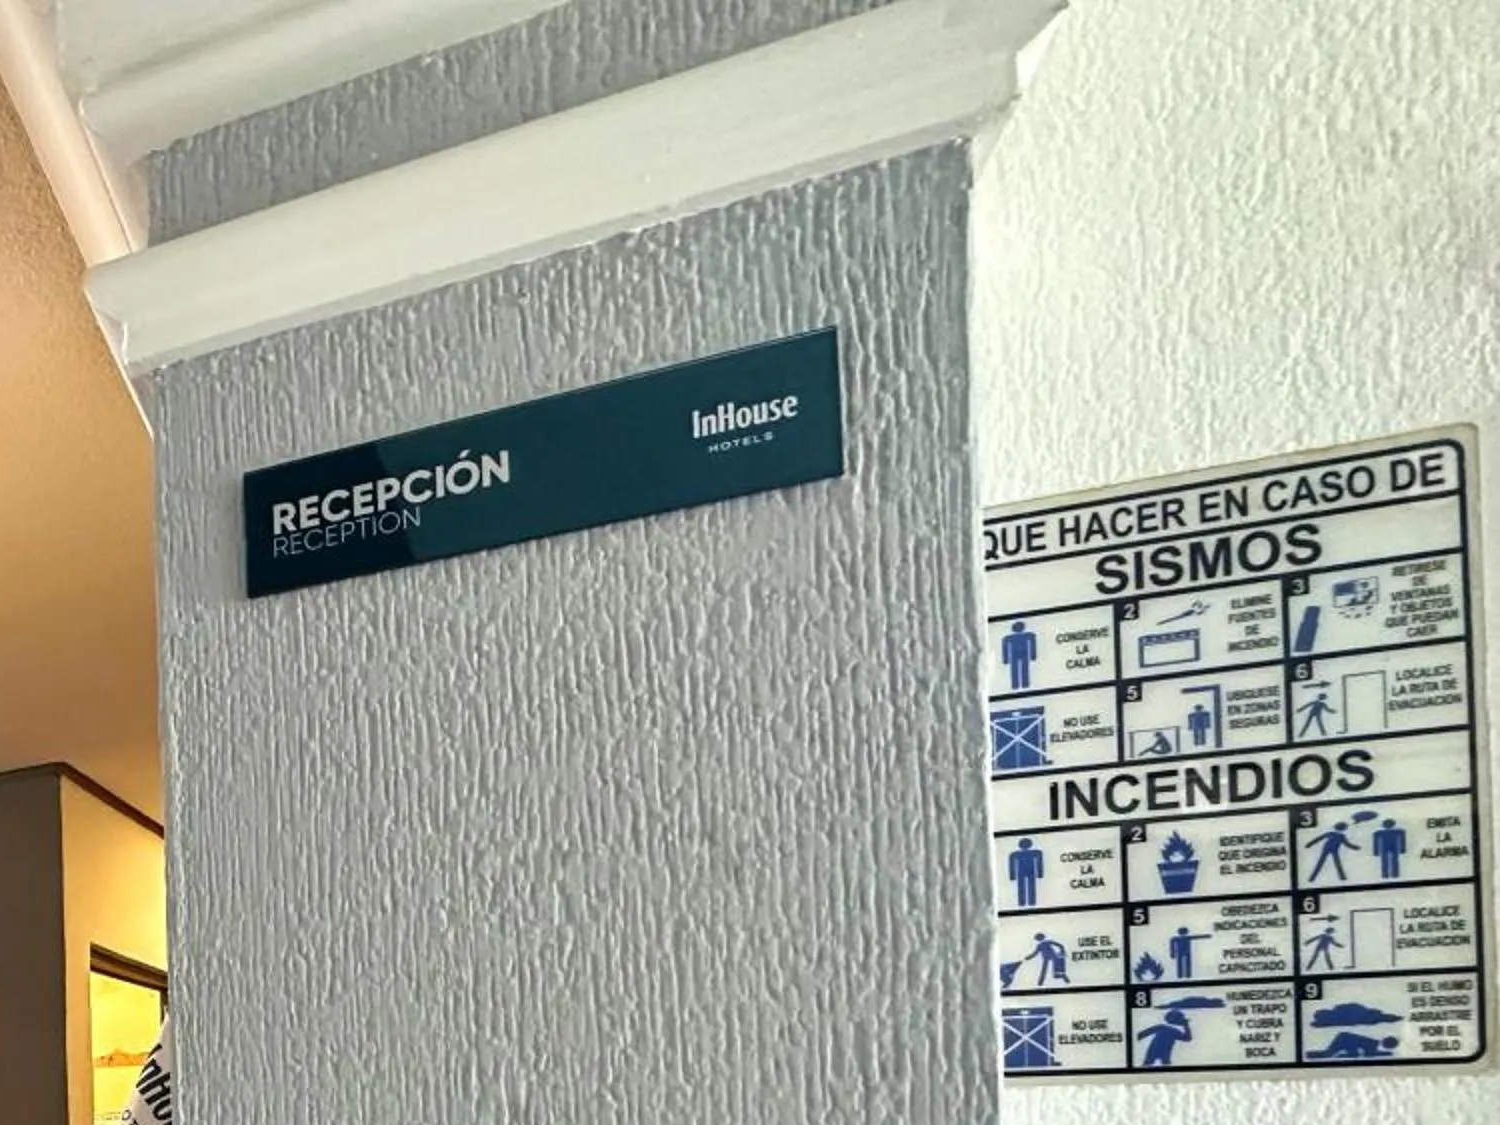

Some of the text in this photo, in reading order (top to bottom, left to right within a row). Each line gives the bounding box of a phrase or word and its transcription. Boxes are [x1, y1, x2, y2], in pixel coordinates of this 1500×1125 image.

[692, 395, 799, 439] InHouse
[708, 431, 773, 453] HOTELS
[272, 449, 510, 535] RECEPCIÓN
[1059, 498, 1187, 547] HACER
[1199, 486, 1249, 524] EN
[1262, 466, 1375, 512] CASO
[1390, 453, 1445, 492] DE
[273, 507, 421, 559] RECEPTION
[1095, 523, 1322, 595] SISMOS
[1291, 578, 1305, 594] 3
[1124, 603, 1137, 618] 2
[1056, 627, 1109, 644] CONSERVE
[1075, 644, 1089, 655] LA
[1065, 656, 1101, 670] CALMA
[1295, 663, 1308, 679] 6
[1396, 664, 1453, 681] LOCALICE
[1126, 685, 1139, 700] 5
[1392, 678, 1458, 697] LA RUTA DE
[1063, 714, 1100, 728] NO USE
[1050, 726, 1114, 742] ELEVADORES
[1049, 749, 1375, 820] INCENDIOS
[1300, 811, 1313, 826] 3
[1426, 816, 1461, 829] EMITA
[1131, 827, 1142, 841] 2
[1436, 832, 1452, 843] LA
[1060, 848, 1113, 862] CONSERVE
[1218, 849, 1240, 861] QUE
[1420, 845, 1469, 859] ALARMA
[1080, 864, 1094, 875] LA
[1219, 864, 1233, 875] EL
[1070, 877, 1105, 889] CALMA
[1303, 897, 1315, 912] 6
[1132, 909, 1145, 923] 5
[1404, 905, 1461, 919] LOCALICE
[1400, 919, 1467, 934] LA RUTA DE
[1077, 935, 1112, 947] USE EL
[1072, 949, 1120, 962] EXTINTOR
[1304, 983, 1318, 999] 9
[1135, 991, 1147, 1007] 8
[1233, 1003, 1287, 1015] UN TRAPO
[1072, 1019, 1108, 1030] NO USE
[1236, 1019, 1244, 1029] Y
[1419, 1025, 1461, 1037] POR EL
[1059, 1032, 1123, 1045] ELEVADORES
[1273, 1032, 1281, 1042] Y
[1244, 1047, 1277, 1058] BOCA
